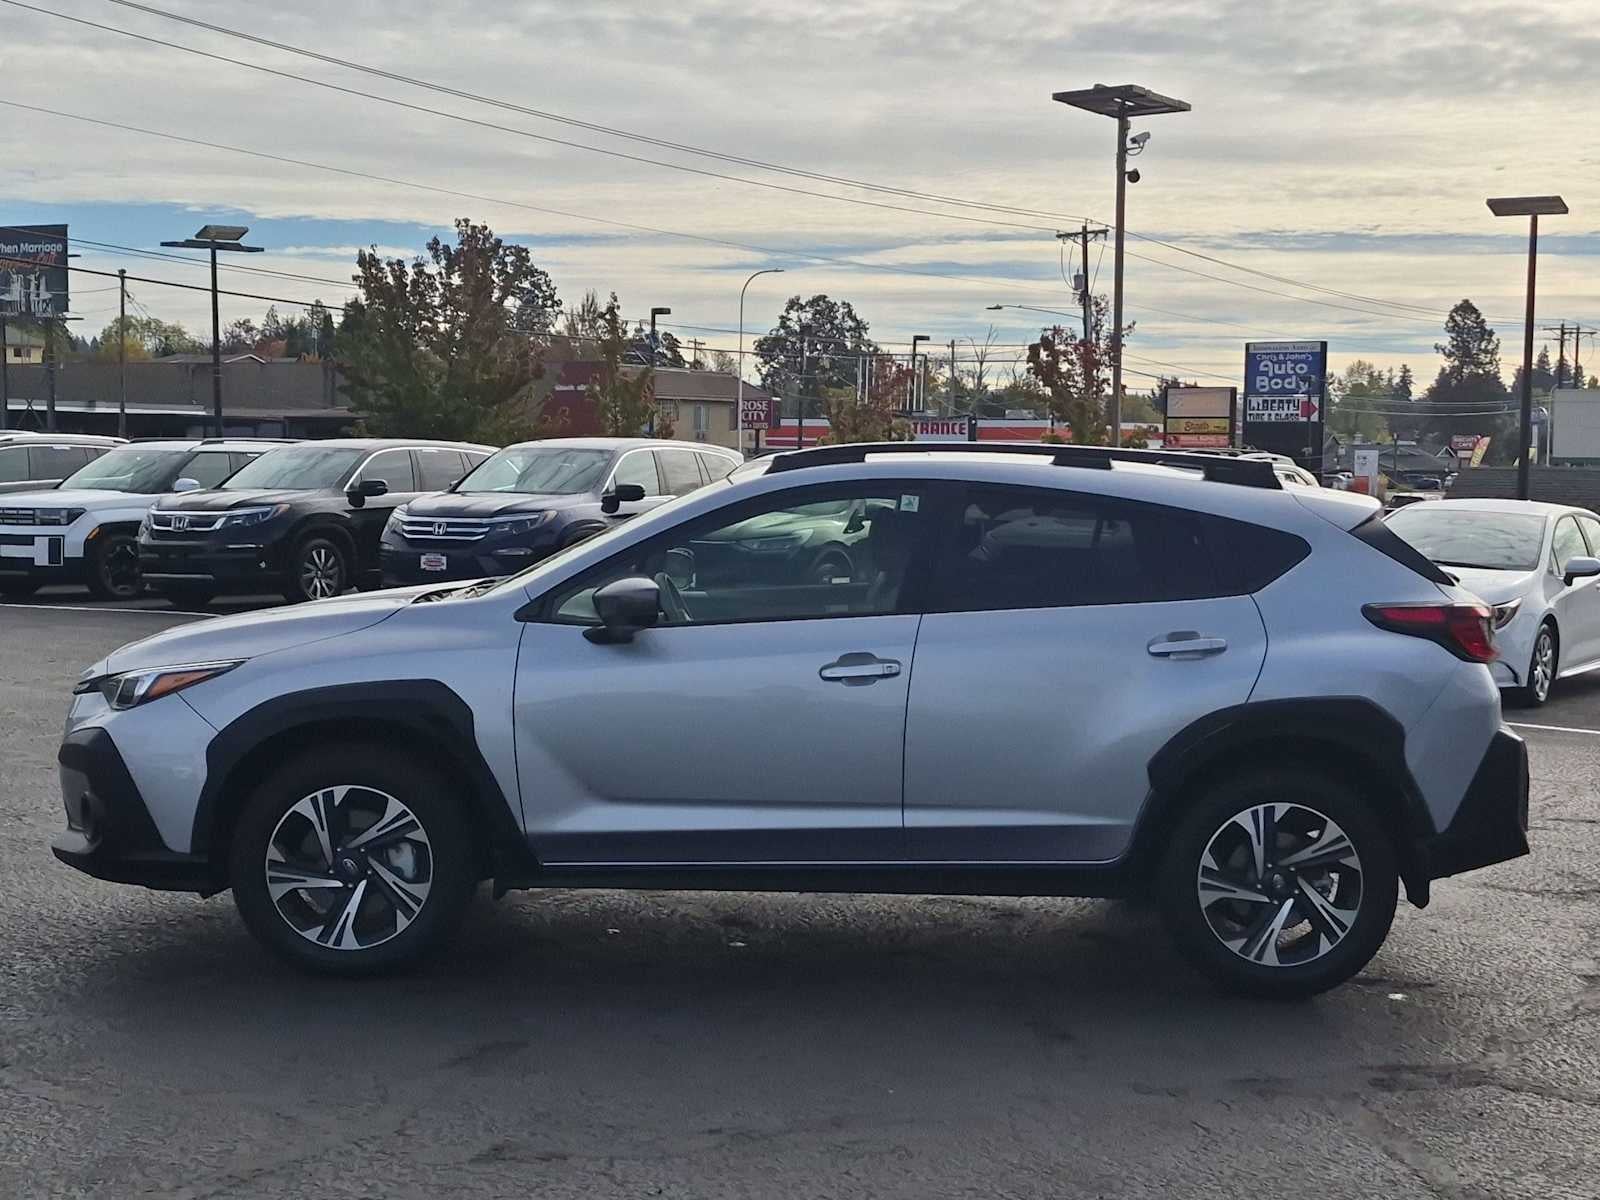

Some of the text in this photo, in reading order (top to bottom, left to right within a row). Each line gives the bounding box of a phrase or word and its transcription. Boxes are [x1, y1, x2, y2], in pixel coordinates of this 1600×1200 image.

[20, 242, 63, 254] Marriage
[1256, 353, 1277, 361] Chris
[1259, 360, 1308, 377] Auto
[1256, 375, 1309, 393] Body
[742, 401, 768, 410] ROSE
[1249, 399, 1300, 411] LIBERTY
[742, 411, 767, 420] CITY
[912, 422, 967, 435] TRANCE
